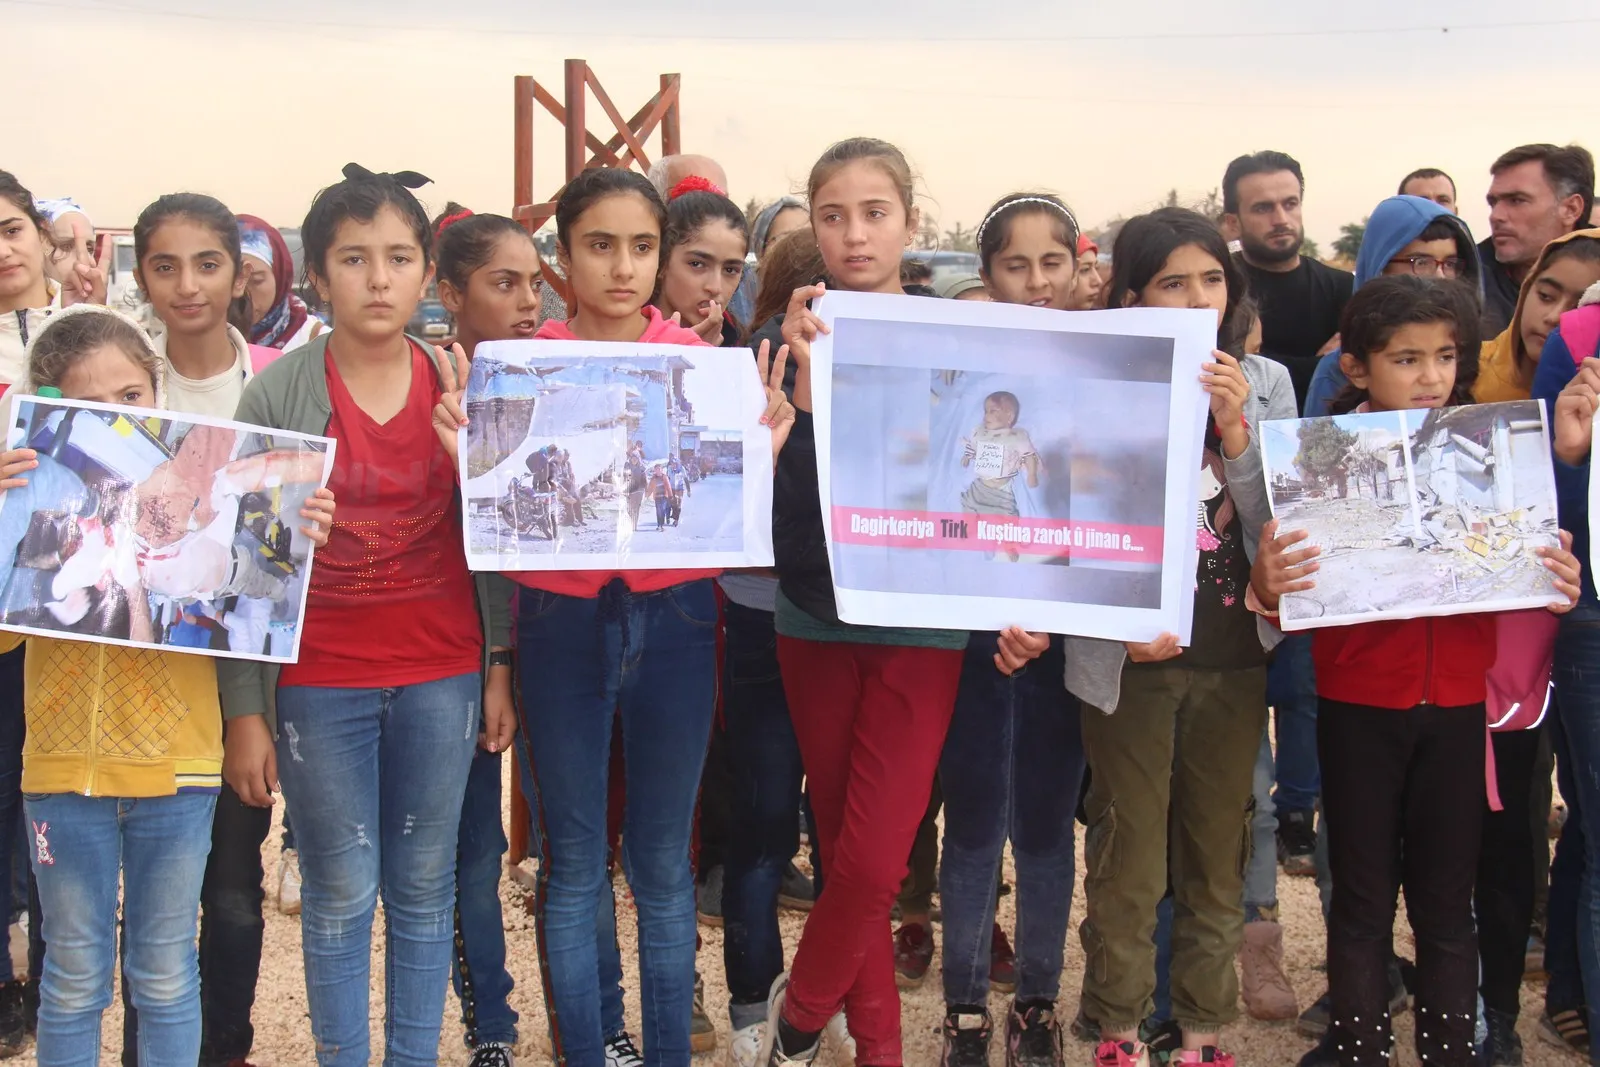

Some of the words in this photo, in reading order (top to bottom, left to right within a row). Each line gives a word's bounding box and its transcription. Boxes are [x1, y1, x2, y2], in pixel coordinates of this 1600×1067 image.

[851, 513, 934, 539] Dagirkeriya
[940, 518, 968, 538] Tirk
[1033, 526, 1071, 546] zarok
[1074, 527, 1083, 546] û
[1085, 528, 1119, 549] jinan
